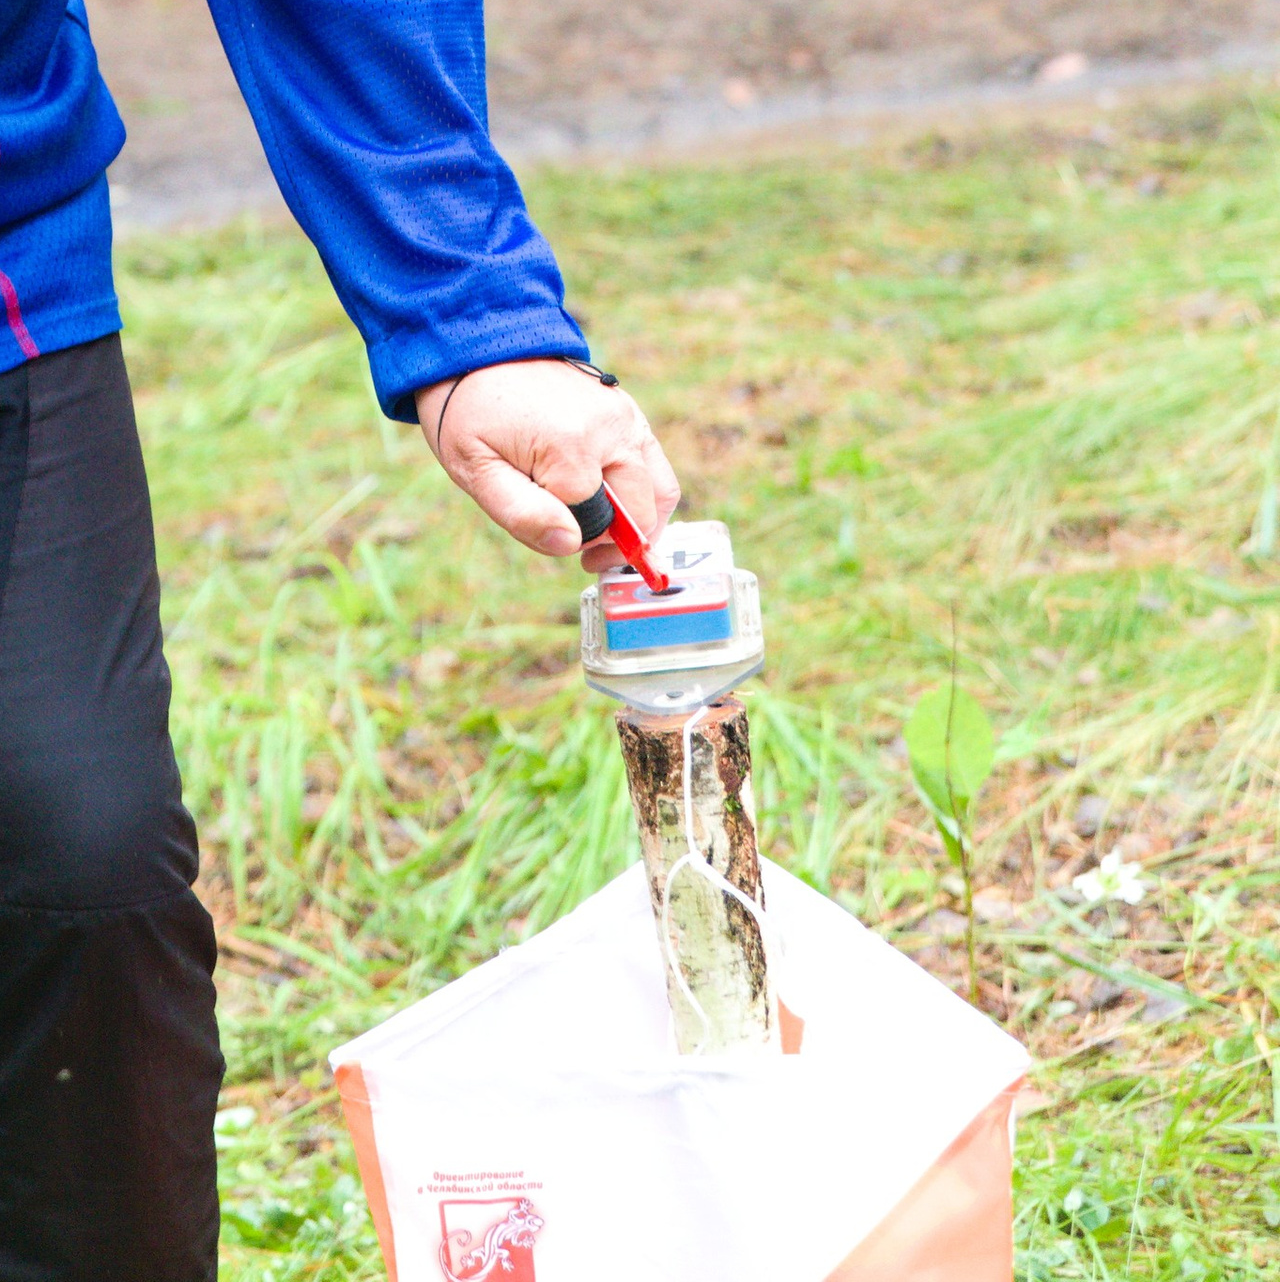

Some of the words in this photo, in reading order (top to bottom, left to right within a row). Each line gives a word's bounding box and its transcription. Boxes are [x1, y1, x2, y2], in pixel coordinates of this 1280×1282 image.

[433, 1170, 524, 1183] Ориентирование
[417, 1186, 424, 1195] в
[426, 1182, 494, 1193] Челябинской
[497, 1181, 543, 1191] области
